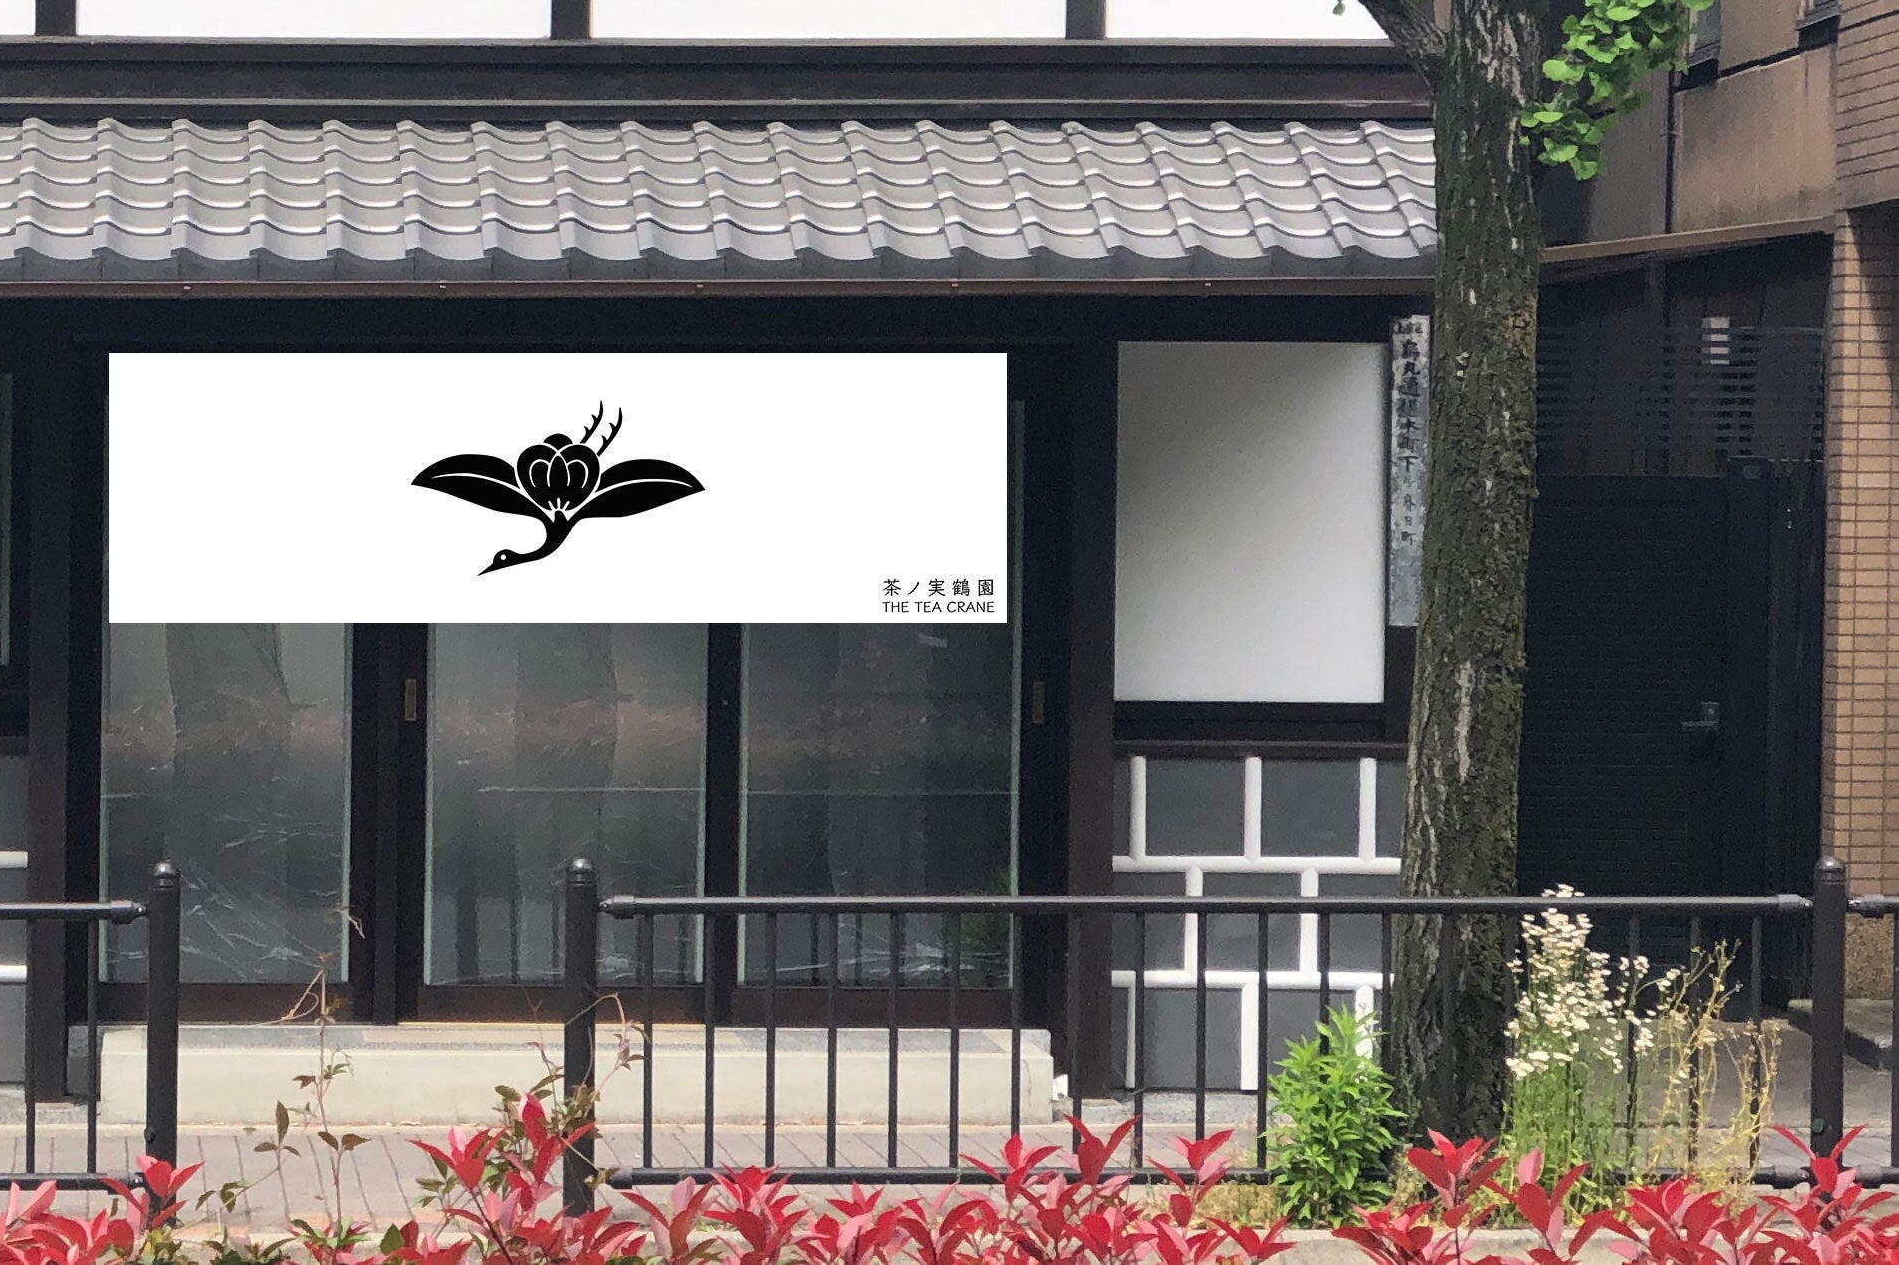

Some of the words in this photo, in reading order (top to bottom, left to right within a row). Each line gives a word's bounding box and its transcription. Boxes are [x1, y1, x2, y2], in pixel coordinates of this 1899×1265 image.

[882, 578, 994, 597] 茶ノ実鶴園
[882, 601, 909, 613] THE
[914, 601, 942, 613] TEA
[946, 601, 995, 613] CRANE
